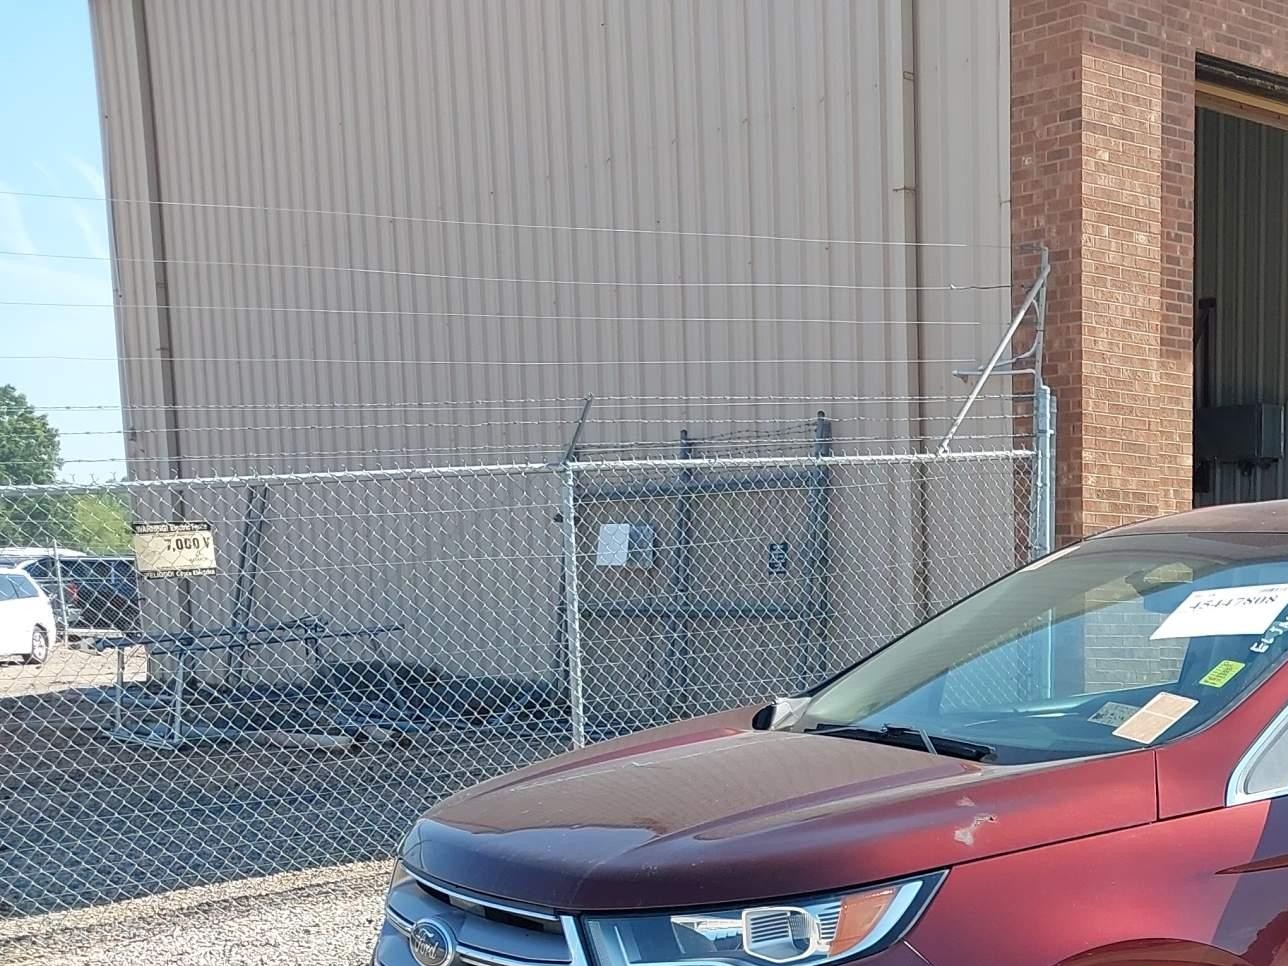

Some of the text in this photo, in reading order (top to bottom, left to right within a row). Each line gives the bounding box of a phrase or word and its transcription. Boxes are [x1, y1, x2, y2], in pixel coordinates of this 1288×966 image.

[163, 536, 211, 552] 7,000 V
[1189, 594, 1279, 610] 45447808
[414, 927, 440, 960] Ford
